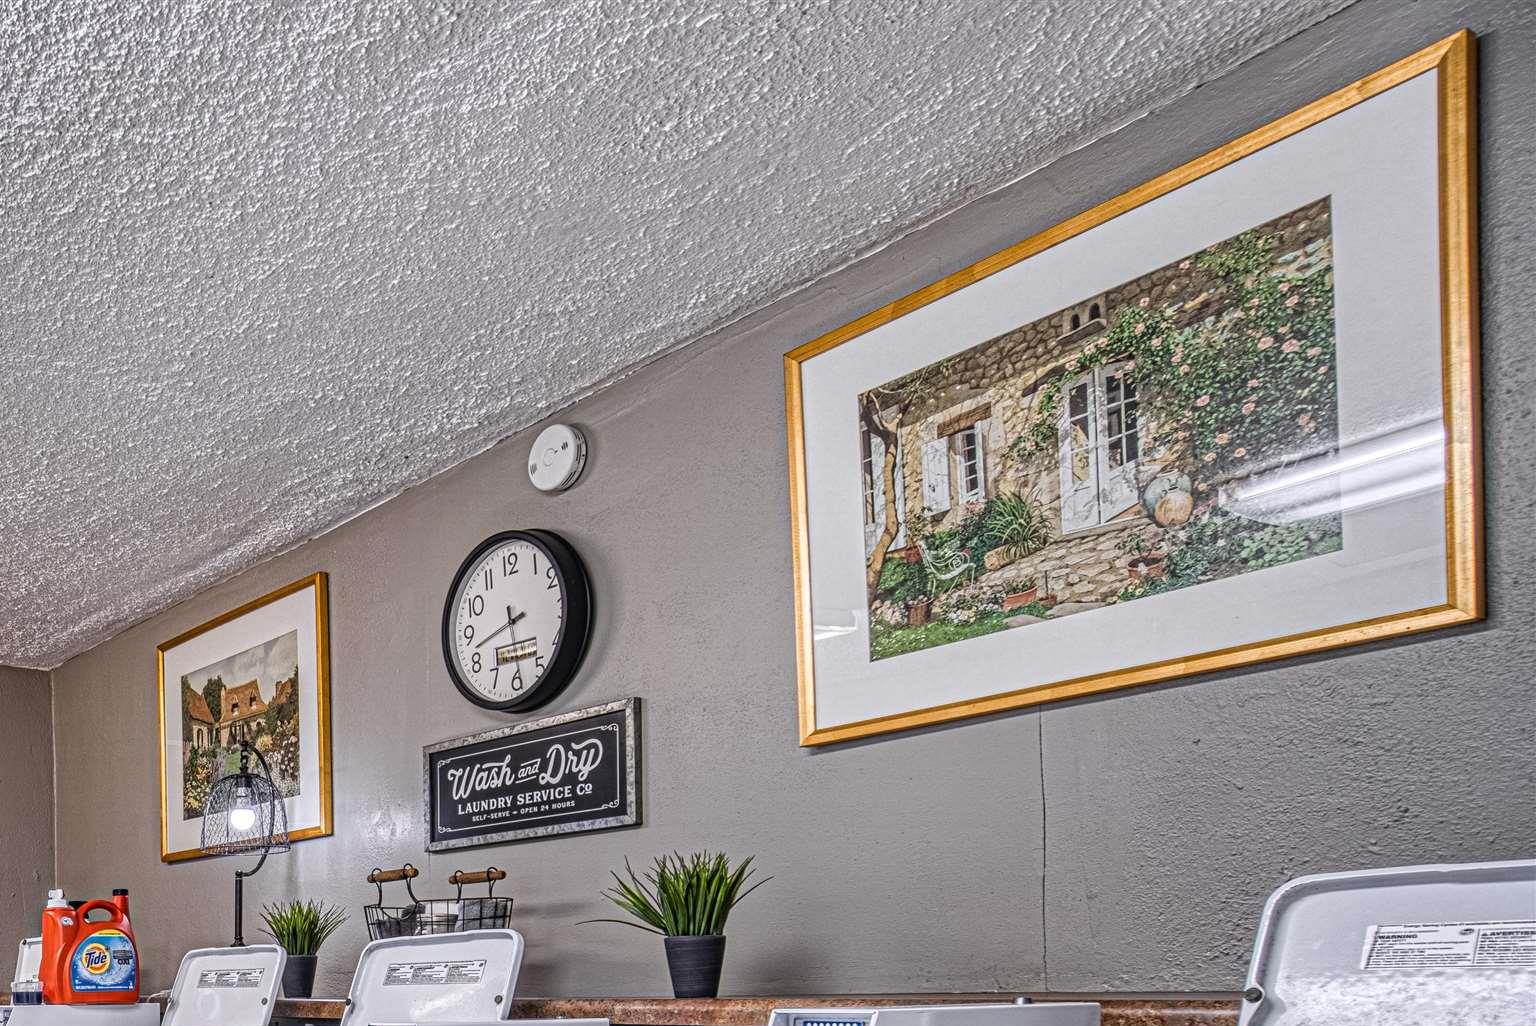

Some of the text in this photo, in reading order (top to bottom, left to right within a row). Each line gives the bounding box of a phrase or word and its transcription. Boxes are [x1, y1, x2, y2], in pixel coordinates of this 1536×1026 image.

[502, 552, 519, 577] 12
[533, 553, 538, 575] 1
[484, 568, 493, 591] 11
[546, 566, 559, 590] 2
[468, 594, 485, 618] 10
[464, 625, 475, 646] 9
[471, 652, 482, 673] 8
[535, 656, 546, 679] 5
[489, 667, 500, 689] 7
[511, 669, 524, 691] 6
[448, 738, 603, 800] Wash and Dry
[458, 795, 513, 815] LAUNDRY
[516, 786, 572, 806] SERVICE
[472, 811, 510, 822] SELF-SERVE
[520, 807, 538, 815] OPEN
[552, 801, 576, 810] HOURS
[85, 951, 107, 968] Tide
